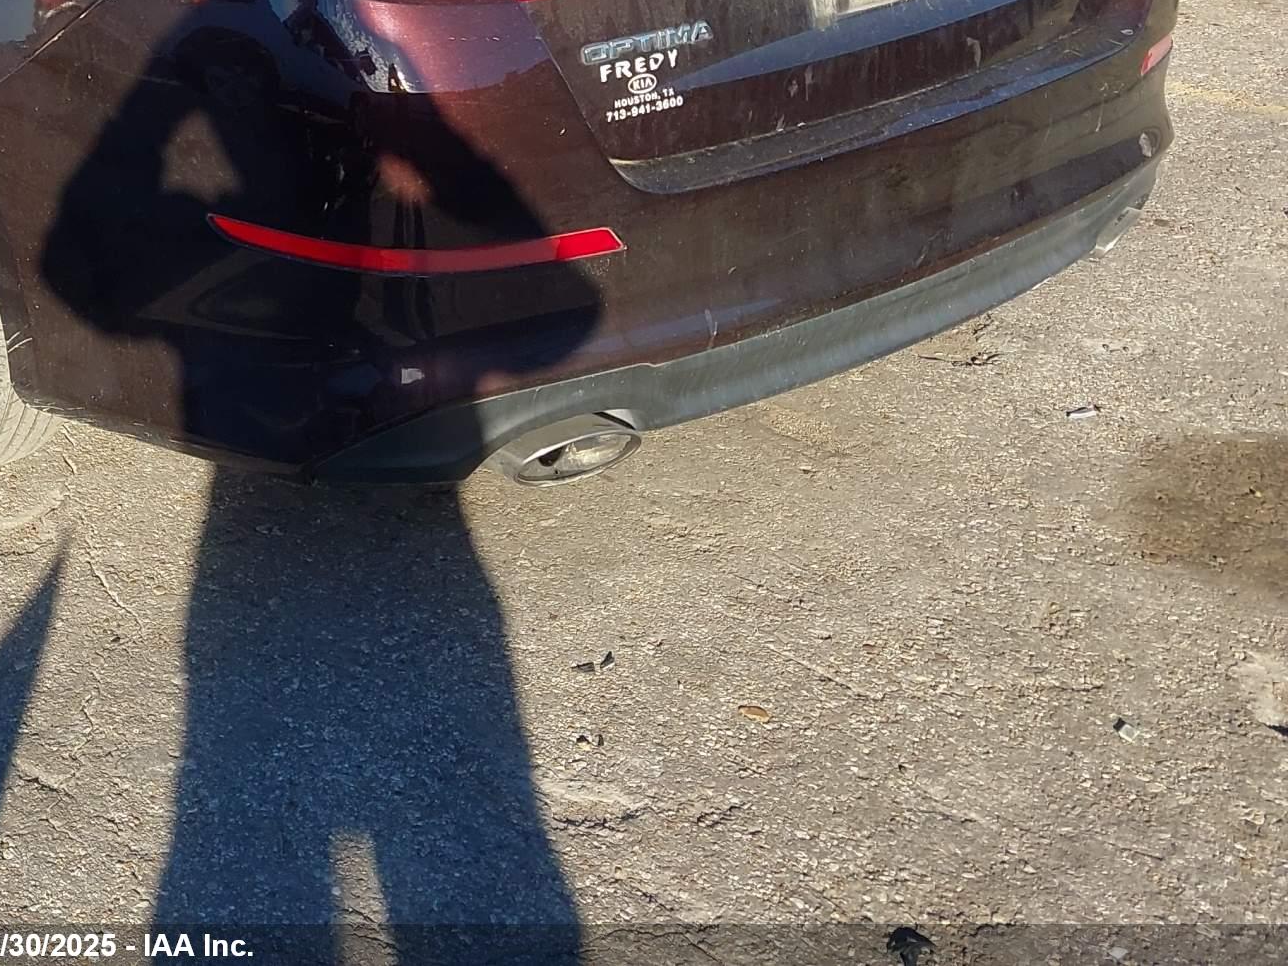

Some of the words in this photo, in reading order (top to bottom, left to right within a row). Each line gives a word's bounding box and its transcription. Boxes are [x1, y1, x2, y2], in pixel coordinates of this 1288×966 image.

[581, 20, 713, 66] OPTIMA
[600, 48, 677, 83] FREDY
[631, 75, 654, 92] KIA
[662, 87, 674, 98] TX
